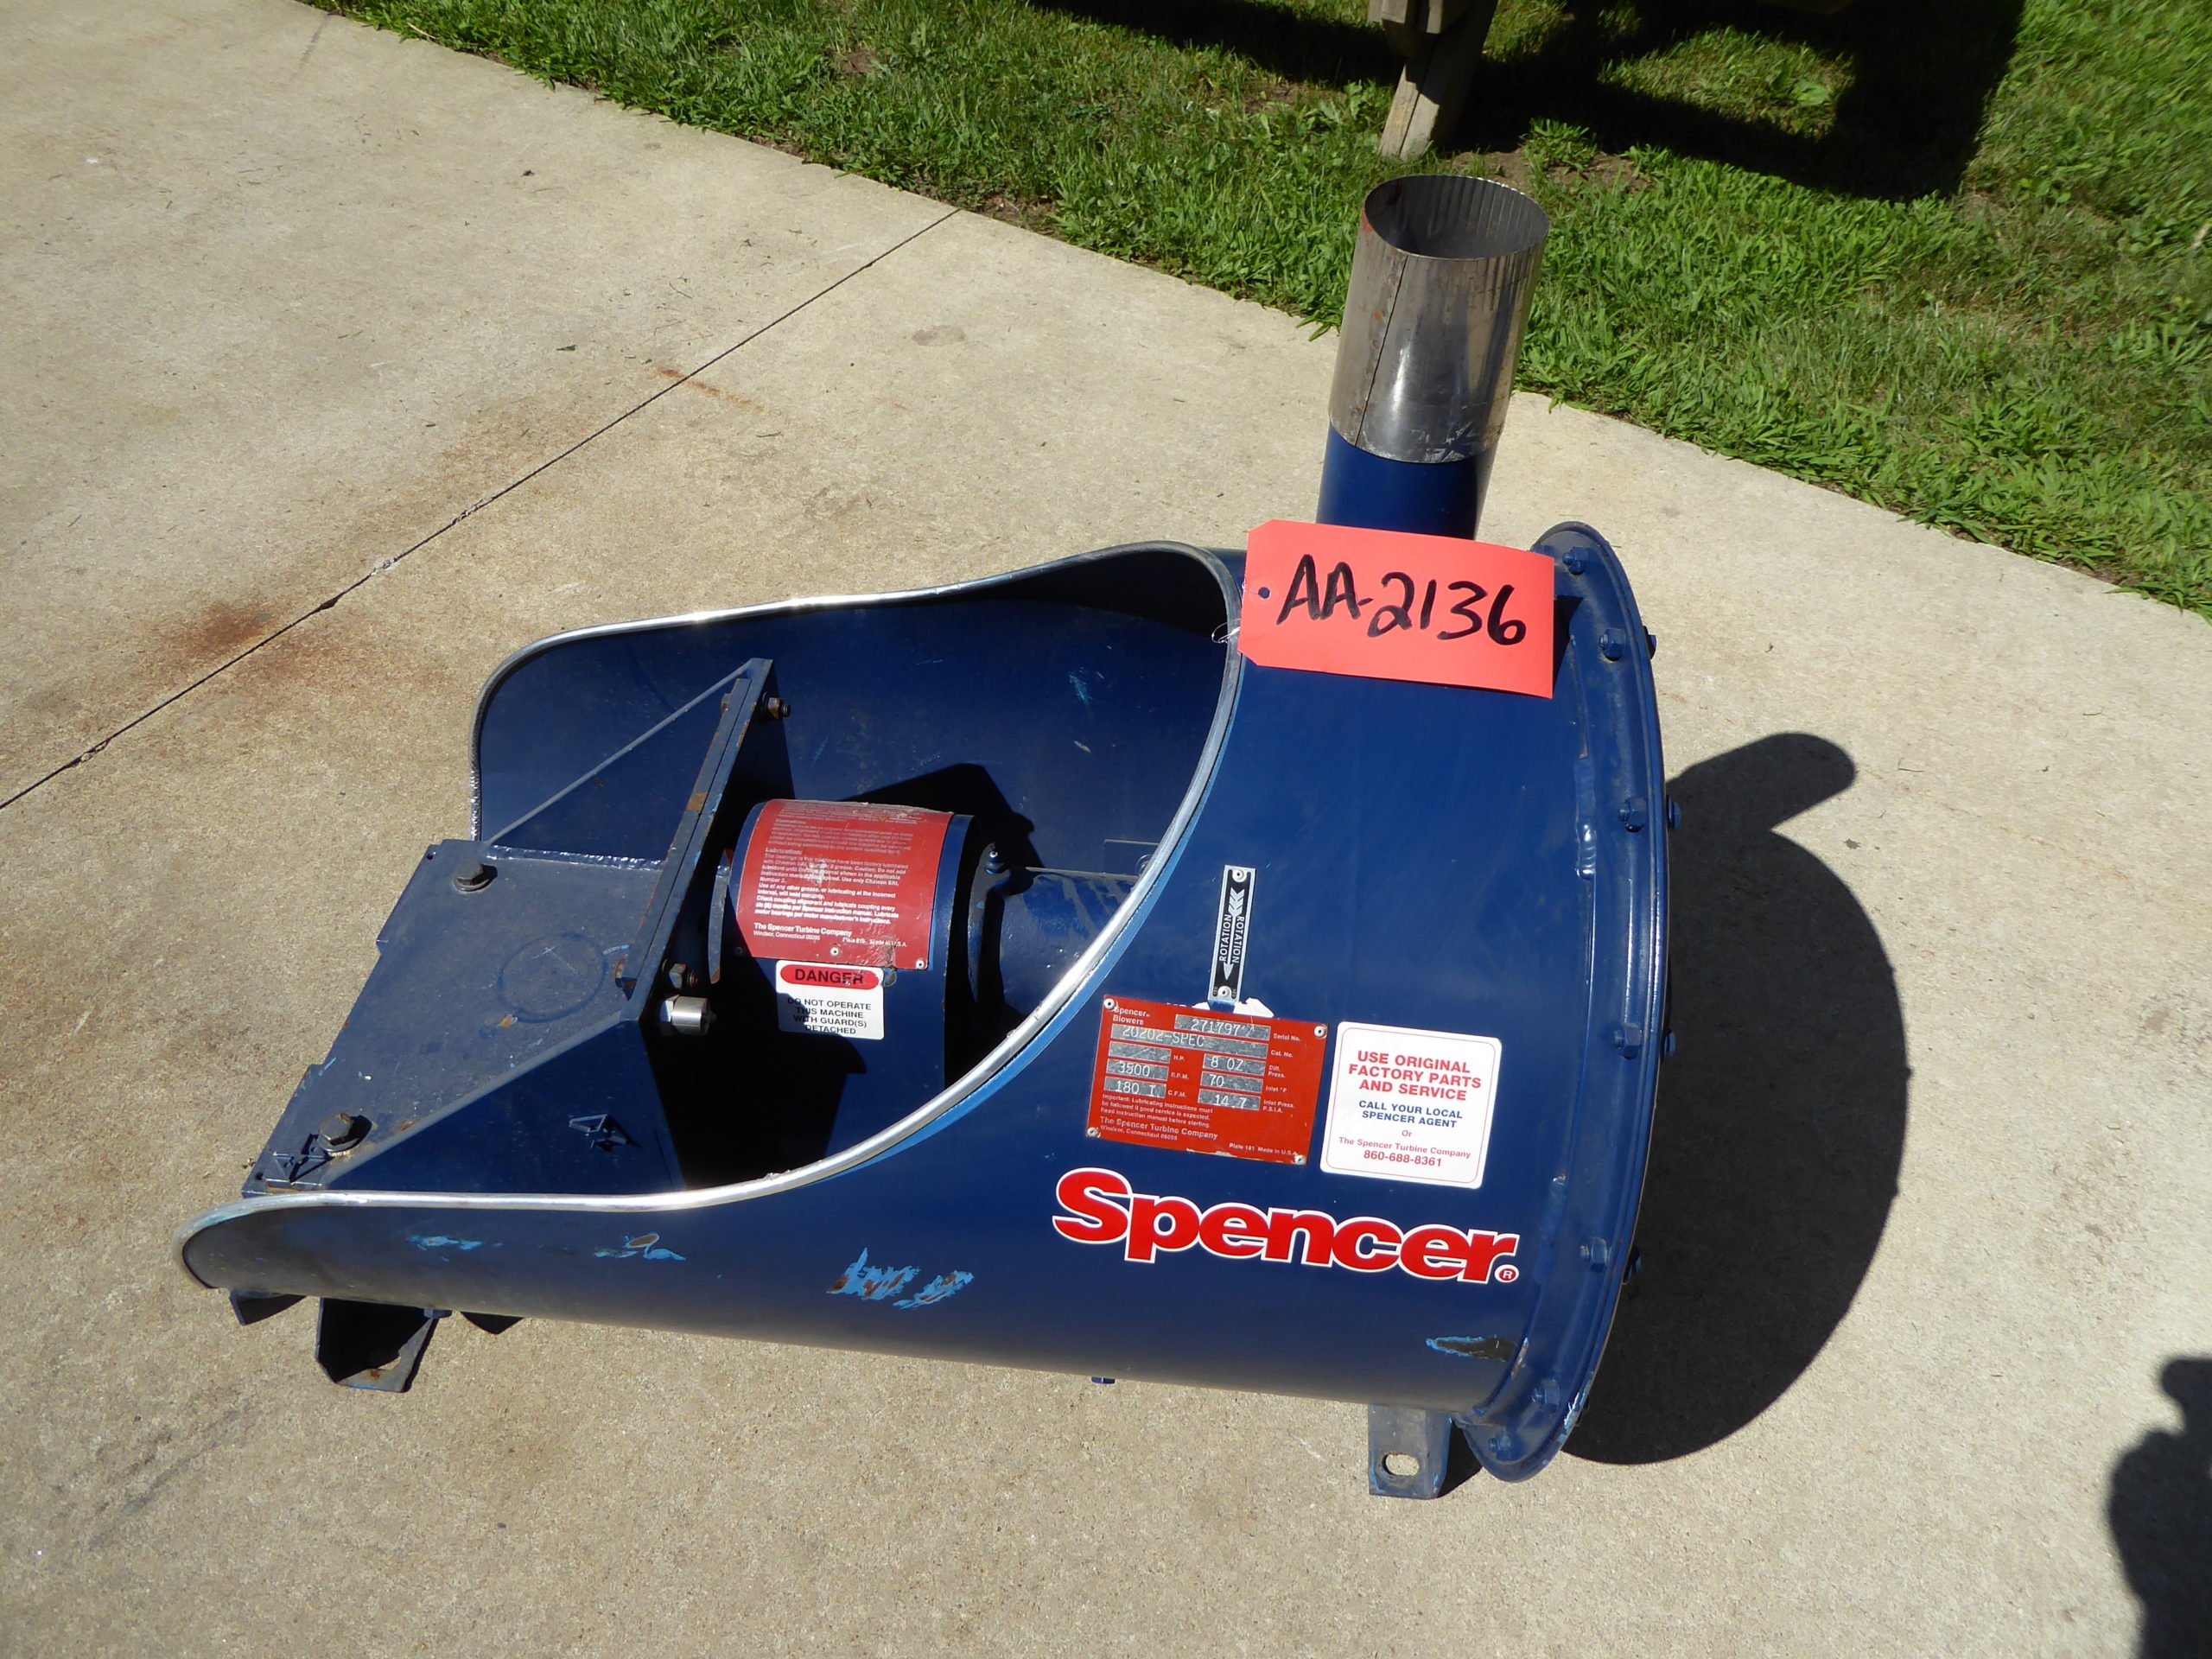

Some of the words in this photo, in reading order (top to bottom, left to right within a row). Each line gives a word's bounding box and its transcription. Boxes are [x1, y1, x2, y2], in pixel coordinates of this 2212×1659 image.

[1276, 553, 1527, 645] AA-2136
[828, 887, 855, 896] lubricating
[767, 924, 795, 932] Spencer
[821, 927, 852, 938] Company
[1219, 913, 1232, 962] ROTATION
[1232, 916, 1245, 963] ROTATION
[795, 969, 863, 985] DANGER
[797, 1007, 817, 1015] THIS
[820, 1008, 863, 1018] MACHINE
[804, 998, 824, 1007] NOT
[826, 1001, 872, 1010] OPERATE
[794, 1014, 817, 1023] WITH
[820, 1017, 868, 1028] GUARD(S)
[1113, 1014, 1144, 1025] Blowers
[805, 1025, 856, 1034] DETACHED
[1122, 1026, 1205, 1046] 20202-SPEC
[1211, 1055, 1219, 1068] 8
[1357, 1050, 1389, 1065] USE
[1395, 1054, 1471, 1074] ORIGINAL
[1209, 1073, 1224, 1088] 70
[1349, 1064, 1424, 1083] FACTORY
[1428, 1072, 1481, 1089] PARTS
[1115, 1080, 1140, 1095] 180
[1358, 1079, 1393, 1093] AND
[1399, 1083, 1467, 1101] SERVICE
[1102, 1093, 1131, 1103] Important:
[1132, 1097, 1164, 1108] Lubricating
[1165, 1102, 1198, 1112] instructions
[1110, 1102, 1134, 1110] followed
[1358, 1100, 1387, 1111] CALL
[1391, 1103, 1422, 1115] YOUR
[1426, 1107, 1463, 1119] LOCAL
[1116, 1109, 1146, 1119] instruction
[1362, 1110, 1415, 1124] SPENCER
[1418, 1116, 1458, 1128] AGENT
[1100, 1116, 1114, 1124] The
[1116, 1118, 1148, 1129] Spencer
[1150, 1123, 1179, 1134] Turbine
[1181, 1128, 1218, 1141] Company
[1126, 1128, 1160, 1139] Connecticut
[1338, 1136, 1354, 1145] The
[1357, 1138, 1392, 1151] Spencer
[1395, 1143, 1427, 1154] Turbine
[1430, 1147, 1471, 1160] Company
[1363, 1149, 1442, 1167] 860-688-8361
[1052, 1166, 1520, 1284] Spencer
